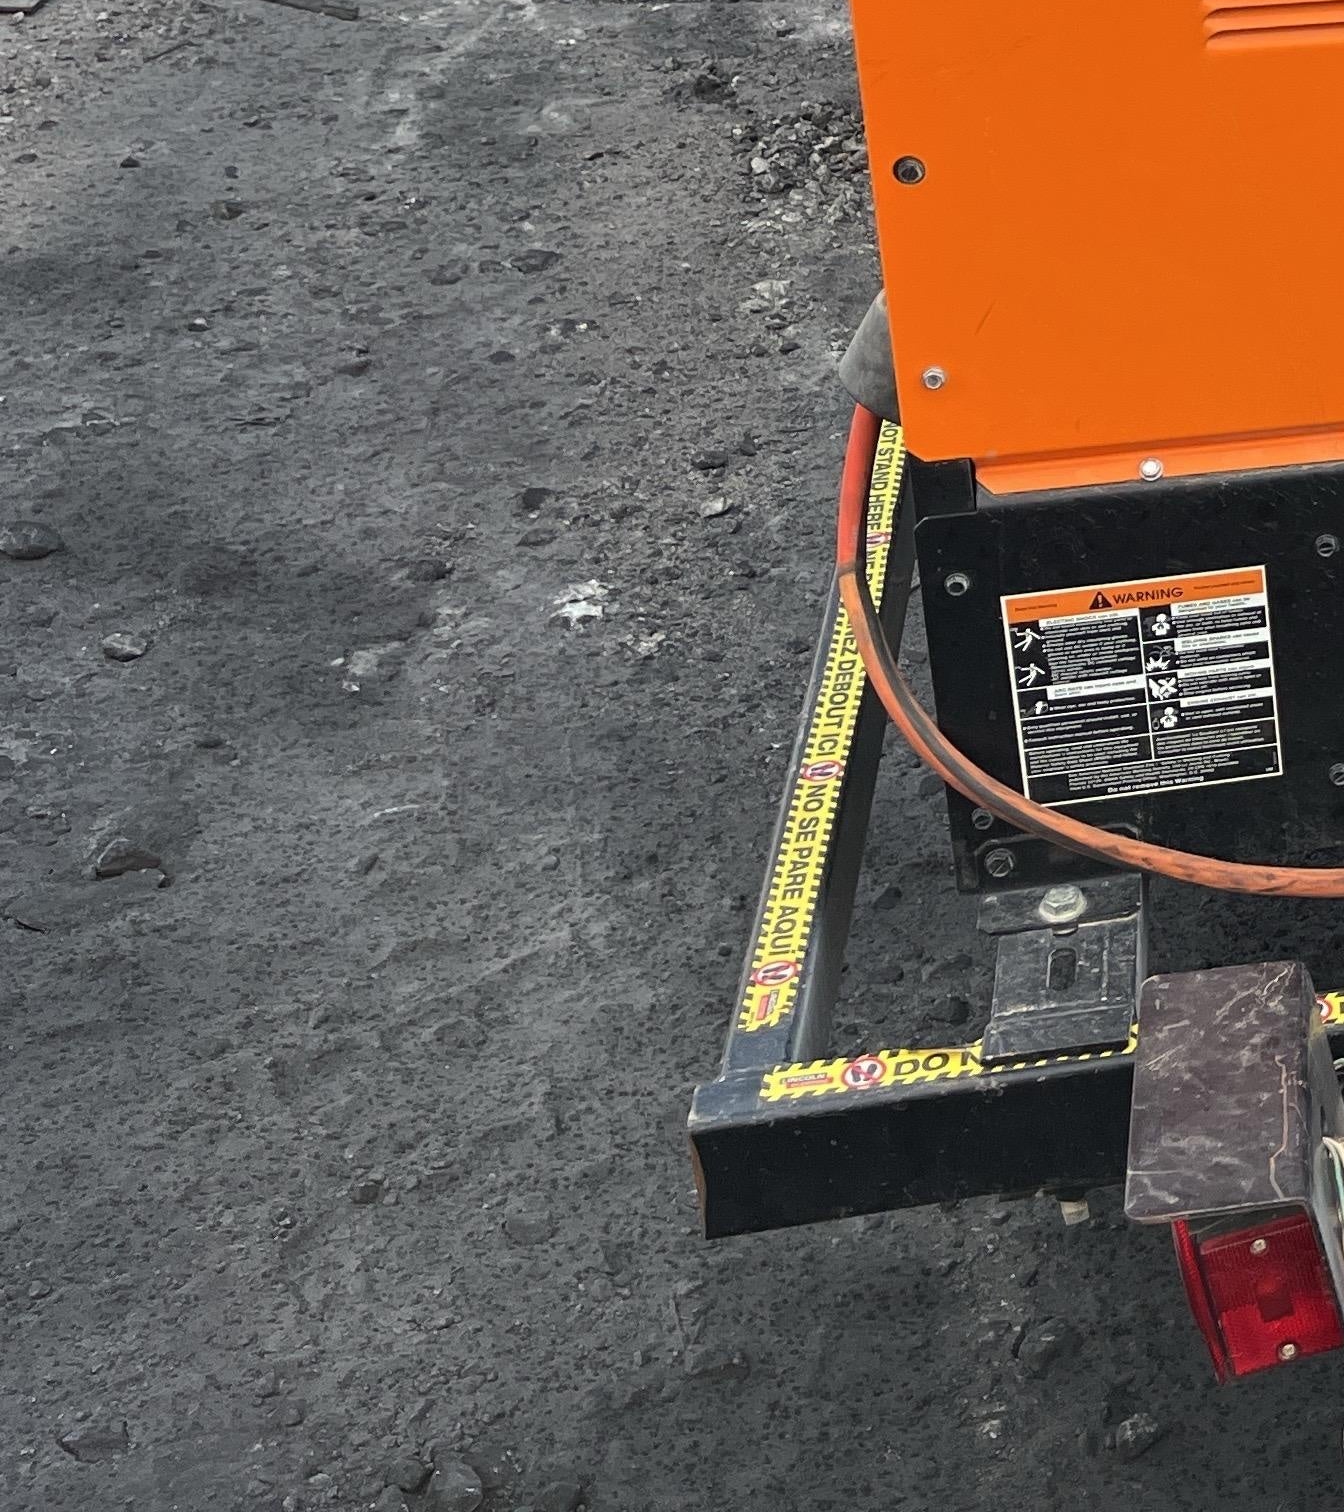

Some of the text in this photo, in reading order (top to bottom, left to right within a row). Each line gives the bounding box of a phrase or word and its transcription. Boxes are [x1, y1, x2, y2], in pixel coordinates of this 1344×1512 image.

[871, 447, 893, 492] STAND
[866, 493, 886, 531] HERE
[1112, 586, 1184, 605] WARNING
[825, 658, 857, 729] DEBOUT
[815, 733, 840, 757] ICI
[802, 783, 828, 813] NO
[795, 817, 820, 844] SE
[782, 845, 813, 902] PARE
[893, 1052, 950, 1077] DO
